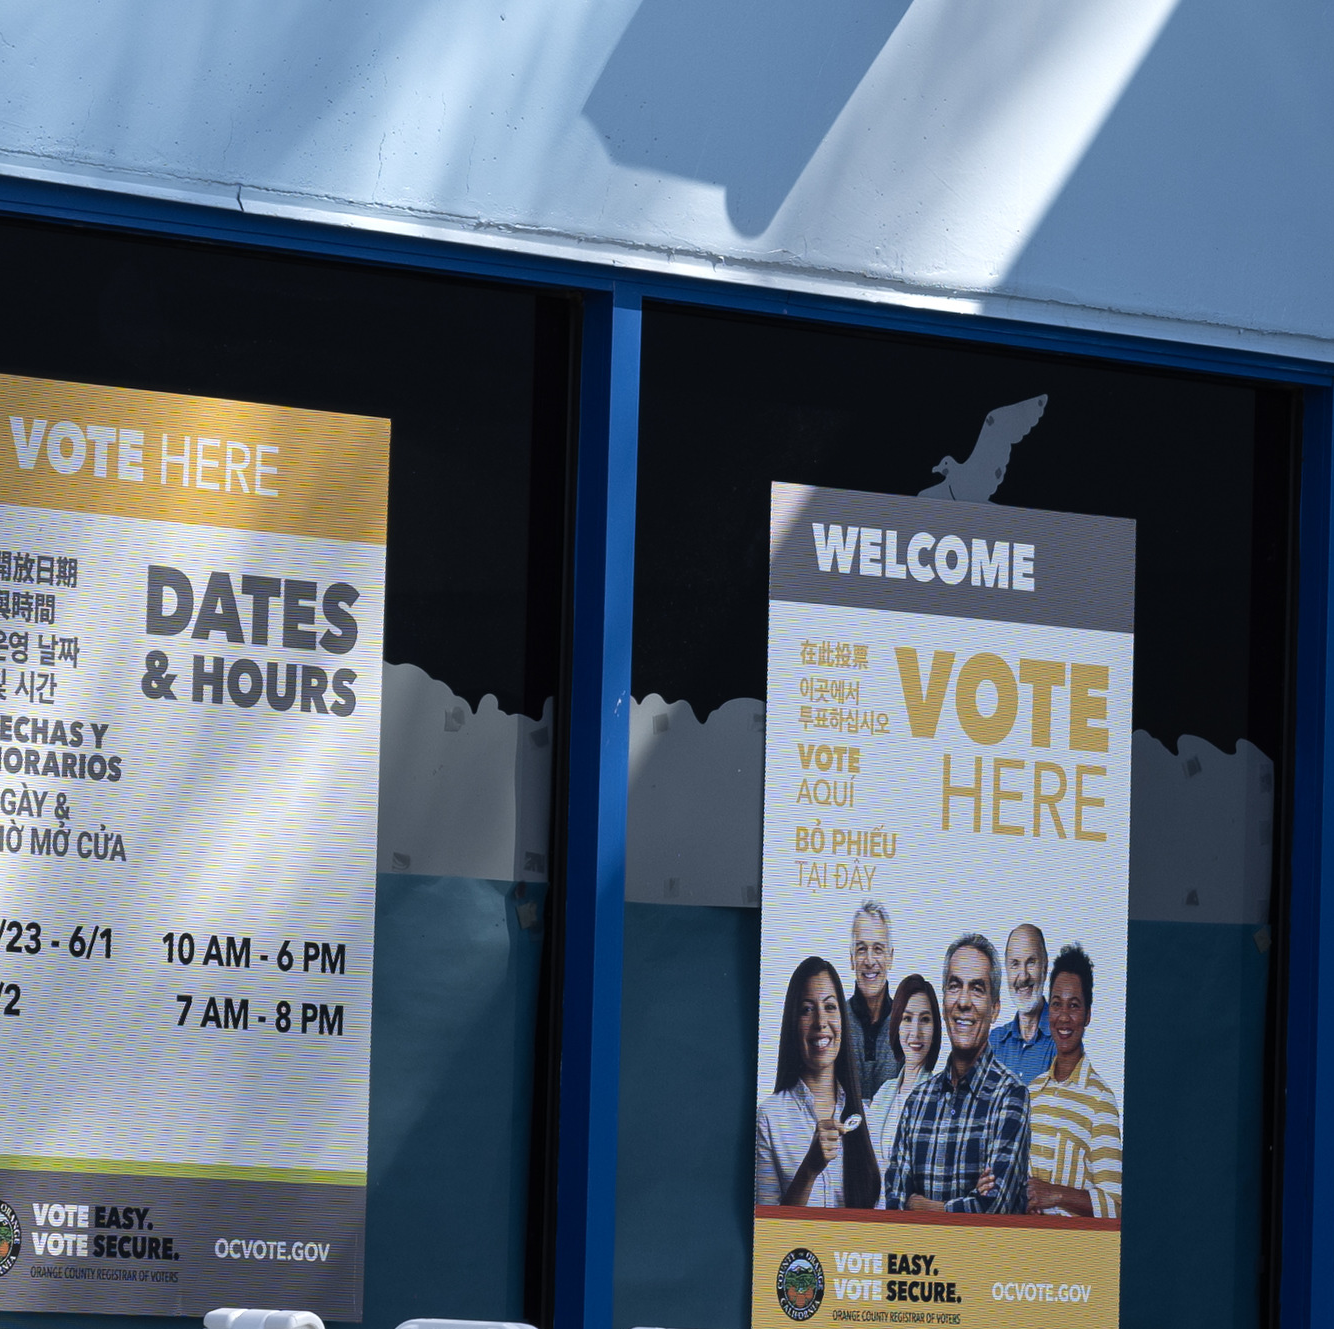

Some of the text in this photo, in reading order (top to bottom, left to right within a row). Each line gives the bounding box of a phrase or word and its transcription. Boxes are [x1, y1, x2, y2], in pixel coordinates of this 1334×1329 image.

[8, 415, 279, 497] VOTE HERE
[811, 522, 1035, 592] WELCOME
[146, 564, 361, 654] DATES
[37, 634, 80, 669] 날짜
[799, 639, 869, 671] 在此投票
[14, 671, 57, 706] 시간
[141, 650, 358, 718] & HOURS
[799, 677, 860, 706] 이곳에서
[894, 646, 1110, 754] VOTE
[91, 722, 109, 749] Y
[798, 704, 891, 736] 투표하십시오
[797, 743, 861, 774] VOTE
[54, 792, 70, 820] &
[796, 776, 855, 808] AQUÍ
[941, 753, 1108, 843] HERE
[30, 821, 71, 857] MỞ
[77, 823, 127, 862] CỬA
[795, 818, 898, 859] BỎ PHIẾU
[794, 857, 877, 893] TẠI ĐÂY
[68, 924, 113, 959] 6/1
[162, 931, 195, 965] 10
[202, 935, 251, 968] AM
[276, 939, 294, 972] 6
[302, 941, 346, 975] PM
[176, 995, 193, 1026] 7
[200, 996, 249, 1030] AM
[275, 1000, 291, 1033] 8
[301, 1002, 344, 1036] PM
[0, 1203, 21, 1245] ORANGE
[31, 1203, 154, 1231] VOTE EASY.
[31, 1231, 180, 1260] VOTE SECURE.
[214, 1237, 330, 1262] OCVOTE.GOV
[30, 1265, 178, 1284] ORANGE COUNTY REGISTRAR OF VOTERS
[833, 1251, 939, 1276] VOTE EASY.
[833, 1278, 962, 1304] VOTE SECURE.
[991, 1281, 1092, 1304] OCVOTE.GOV
[832, 1309, 961, 1325] ORANGE COUNTY REGISTRAR OF VOTERS
